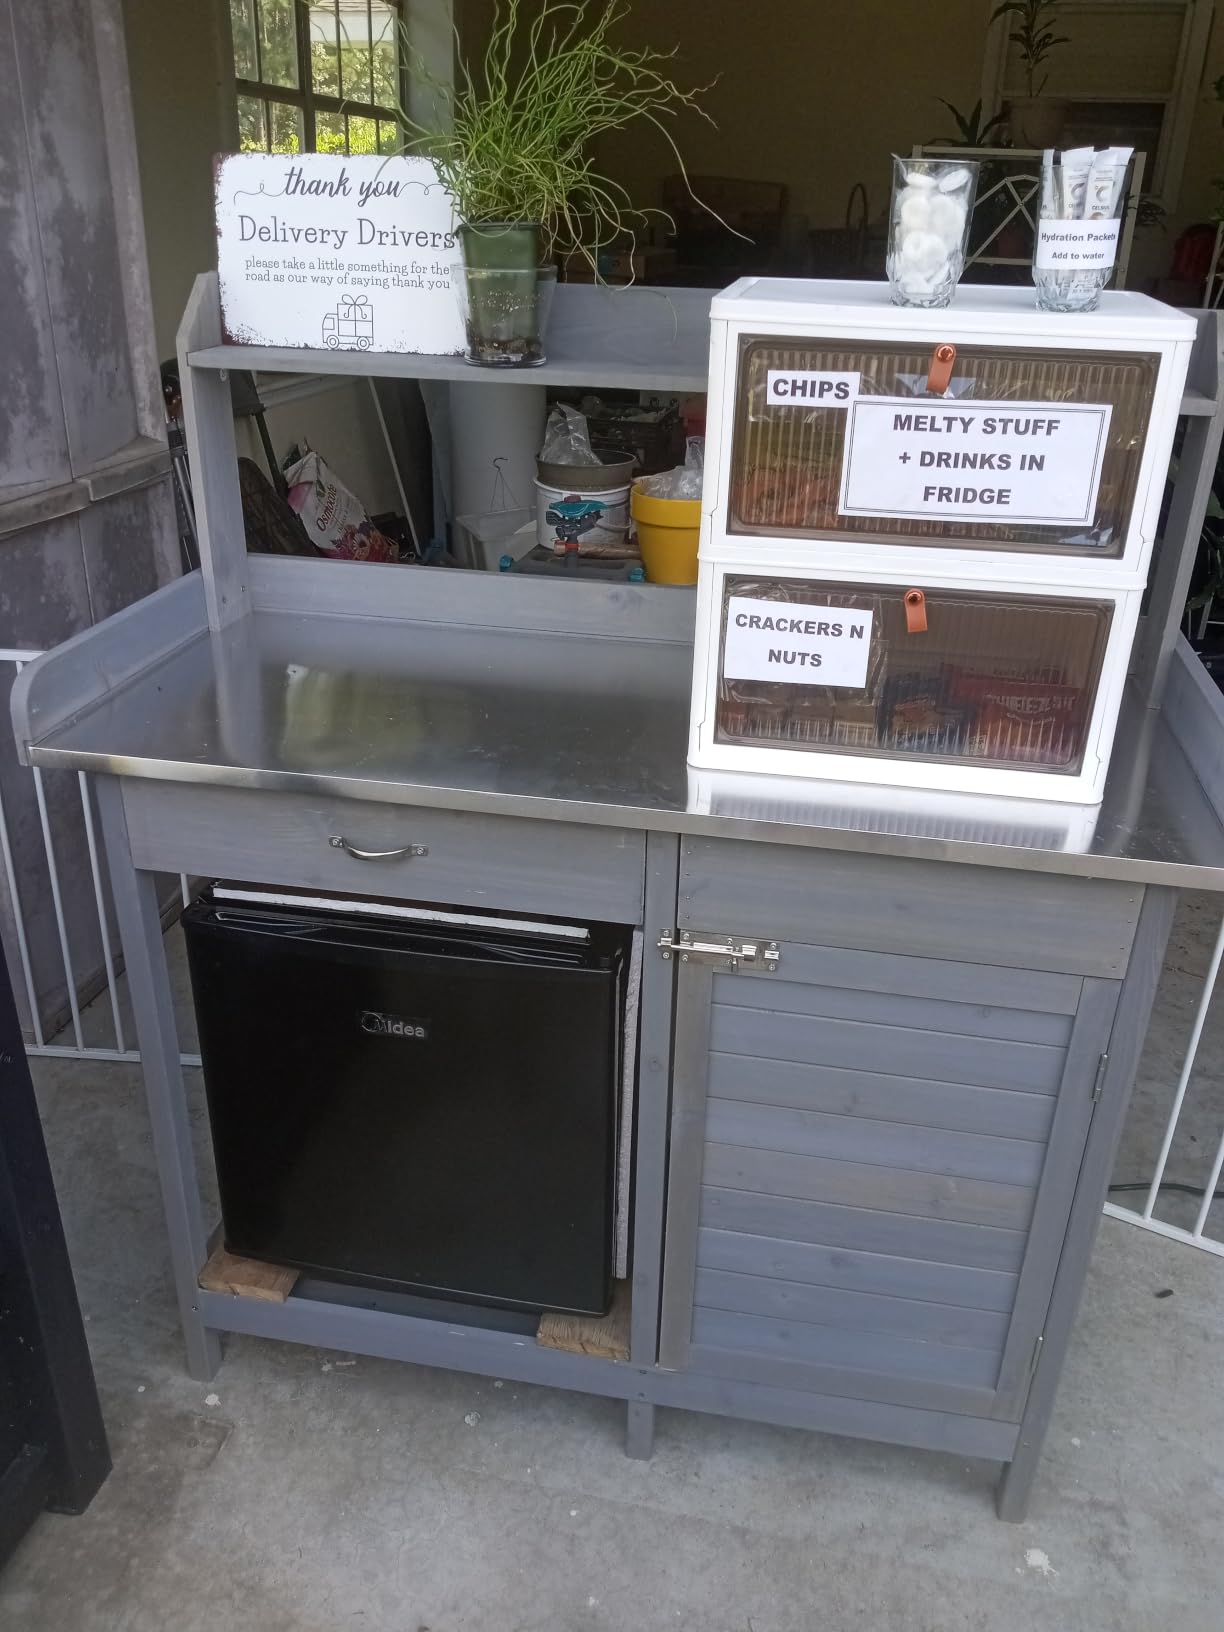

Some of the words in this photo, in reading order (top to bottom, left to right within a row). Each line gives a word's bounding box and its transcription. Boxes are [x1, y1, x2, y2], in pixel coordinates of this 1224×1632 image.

[284, 166, 352, 198] thank
[358, 179, 401, 207] you
[238, 215, 348, 250] Delivery
[356, 218, 455, 250] Drivers
[1041, 232, 1084, 242] Hydration
[1087, 233, 1116, 241] Packets
[245, 255, 280, 270] please
[282, 256, 306, 270] take
[308, 261, 315, 270] a
[317, 258, 345, 271] little
[347, 259, 409, 277] something
[410, 261, 428, 274] for
[430, 261, 450, 275] the
[1051, 252, 1068, 260] Add
[1070, 252, 1080, 260] to
[1082, 252, 1105, 260] water
[245, 269, 271, 282] road
[273, 273, 285, 283] as
[287, 274, 308, 283] our
[311, 275, 334, 287] way
[336, 272, 350, 285] of
[351, 275, 390, 290] saying
[392, 273, 425, 289] thank
[426, 279, 450, 290] you
[772, 378, 850, 400] CHIPS
[893, 413, 976, 435] MELTY
[981, 416, 1061, 437] STUFF
[898, 451, 911, 465] +
[919, 450, 1012, 472] DRINKS
[1019, 453, 1046, 472] IN
[922, 486, 1012, 506] FRIDGE
[735, 613, 843, 638] CRACKERS
[850, 624, 865, 639] N
[768, 648, 823, 667] NUTS
